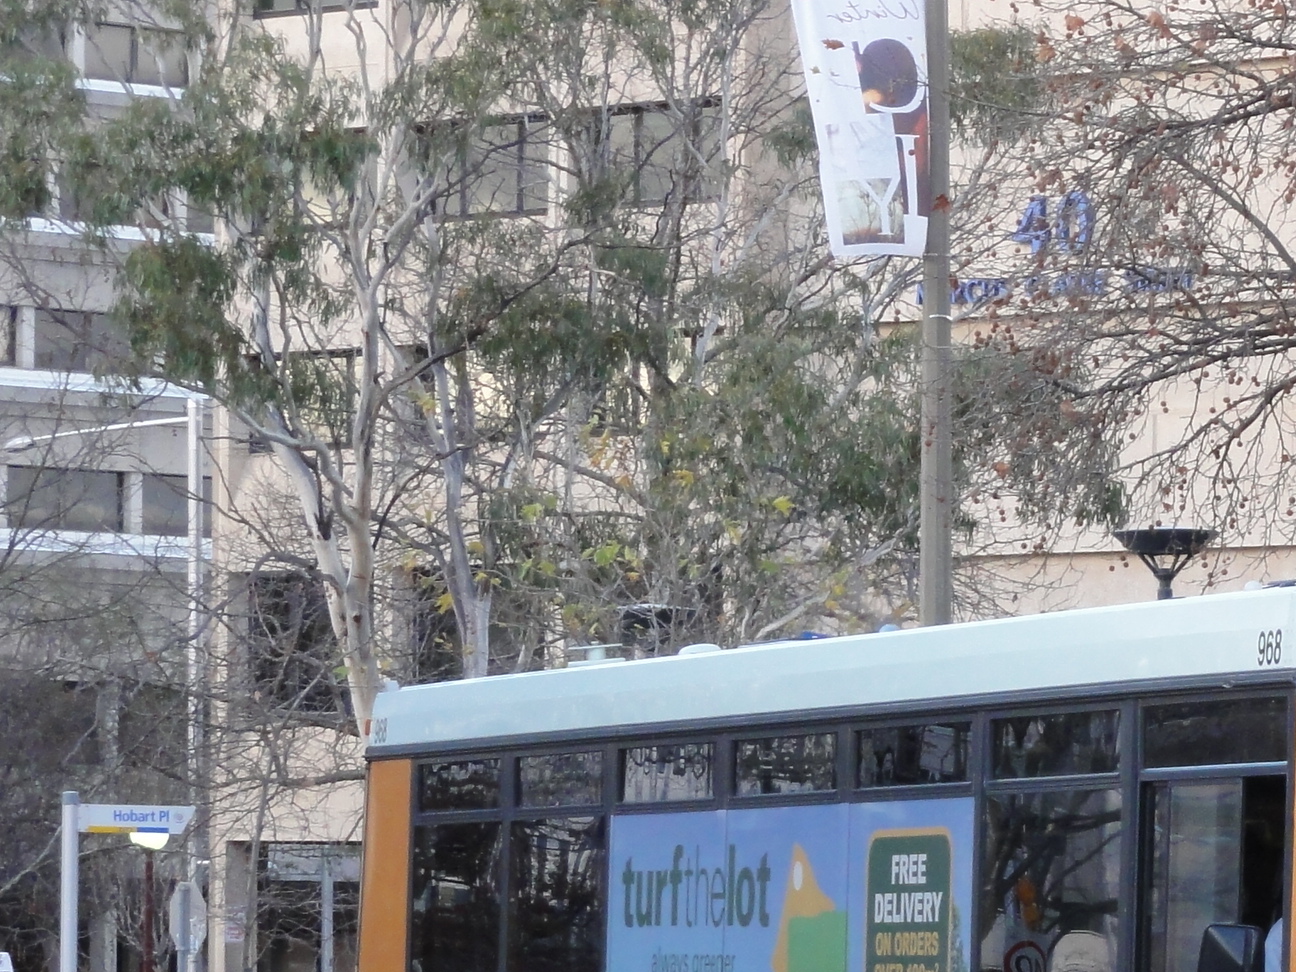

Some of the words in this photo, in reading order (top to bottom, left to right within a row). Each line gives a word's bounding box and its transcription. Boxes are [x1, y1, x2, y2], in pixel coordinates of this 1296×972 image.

[1012, 190, 1097, 255] 40
[1257, 628, 1282, 666] 968
[113, 809, 156, 823] Hobart
[159, 810, 170, 822] Pl
[890, 853, 927, 885] FREE
[622, 844, 771, 928] turfthelot
[874, 891, 943, 923] DELIVERY
[875, 932, 892, 956] ON
[894, 931, 939, 956] ORDERS
